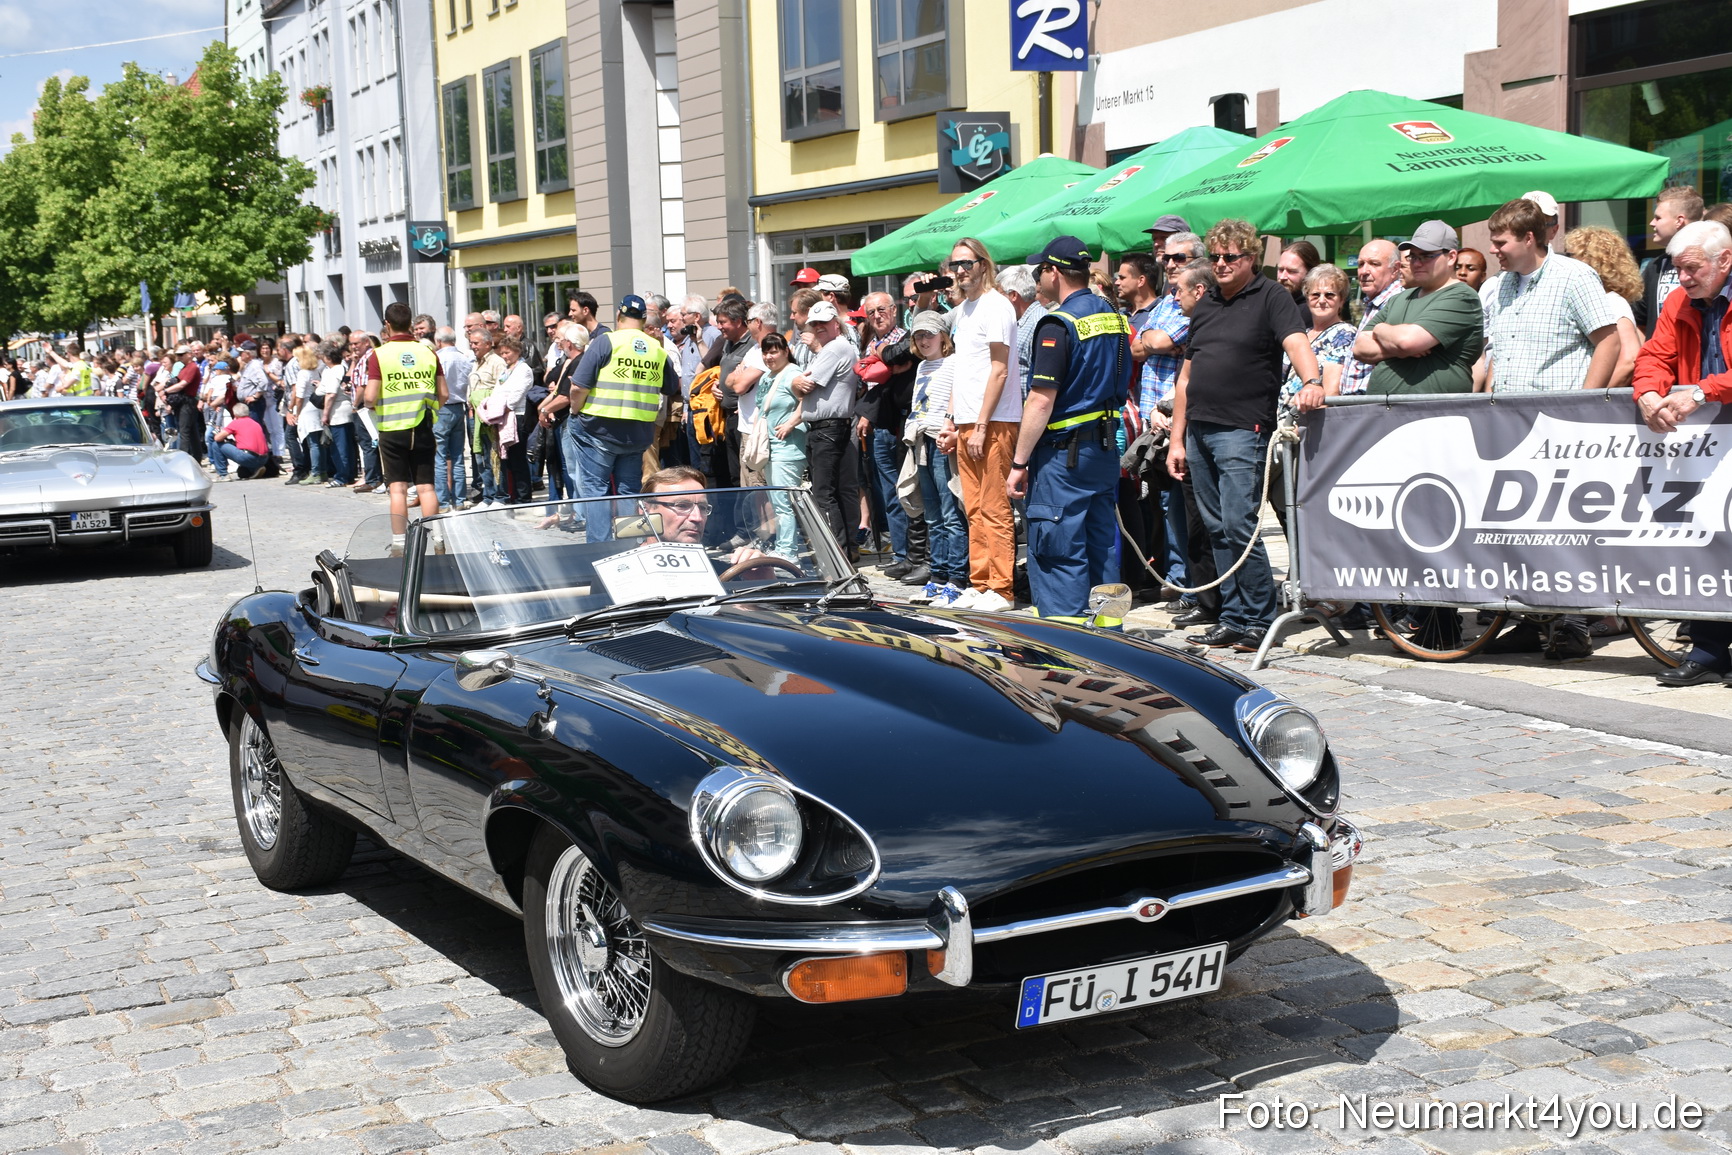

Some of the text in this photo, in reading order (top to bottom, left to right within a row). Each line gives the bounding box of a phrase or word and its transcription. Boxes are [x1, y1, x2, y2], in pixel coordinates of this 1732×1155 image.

[1096, 85, 1154, 111] Unterer Markt 15
[968, 133, 994, 167] G2
[1395, 145, 1510, 161] Neumarkter
[1385, 152, 1547, 173] Lammsbräu
[422, 232, 437, 249] G2
[618, 358, 660, 370] FOLLOW
[387, 370, 432, 381] FOLLOW
[632, 370, 647, 380] ME
[403, 381, 420, 390] ME
[1530, 433, 1719, 460] Autoklassik
[1480, 466, 1705, 523] Dietz
[80, 512, 92, 520] NM
[75, 519, 107, 529] AA 529
[1473, 532, 1592, 546] BREITENBRUNN
[653, 554, 691, 568] 361
[1043, 950, 1222, 1017] FÜ I 54H
[1025, 1006, 1035, 1018] D
